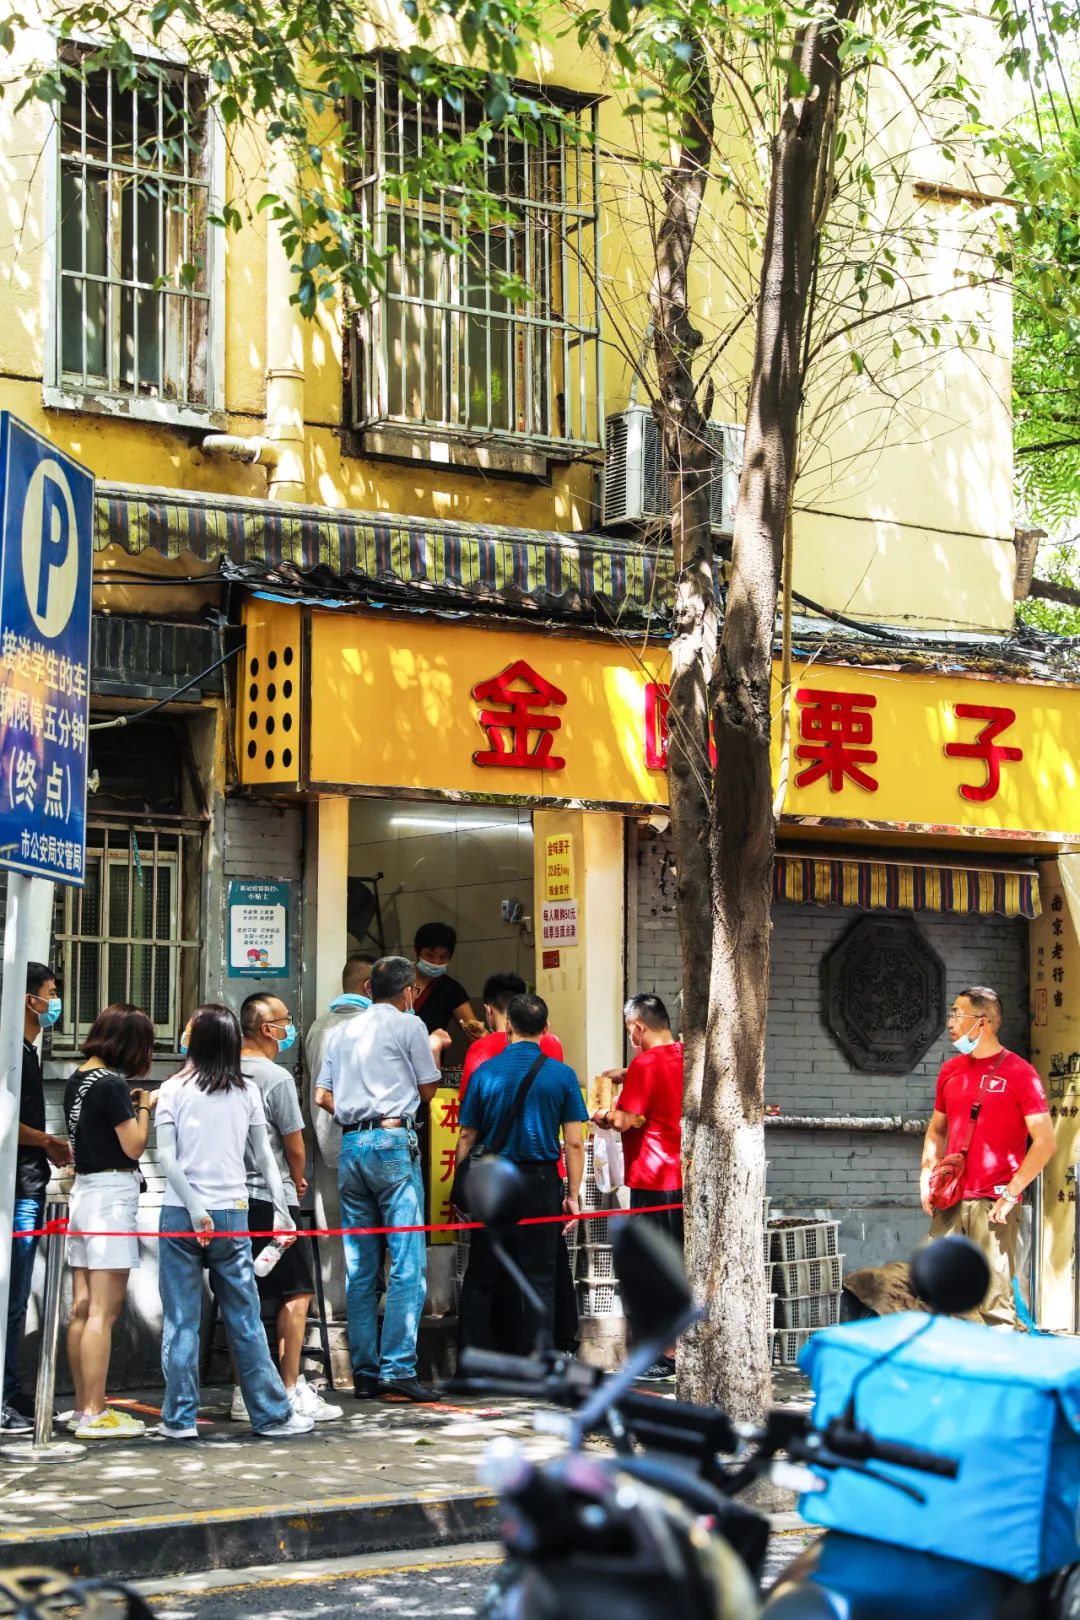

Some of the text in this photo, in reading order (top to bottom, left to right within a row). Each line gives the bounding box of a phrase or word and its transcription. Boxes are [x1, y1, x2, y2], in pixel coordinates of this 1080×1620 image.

[37, 473, 69, 618] P
[2, 626, 87, 701] 接送学生的车
[0, 683, 86, 754] 辆限停五分钟
[21, 828, 82, 873] 市公安局交管局
[547, 840, 570, 856] 金味栗子
[1051, 894, 1065, 1008] 南京老行当
